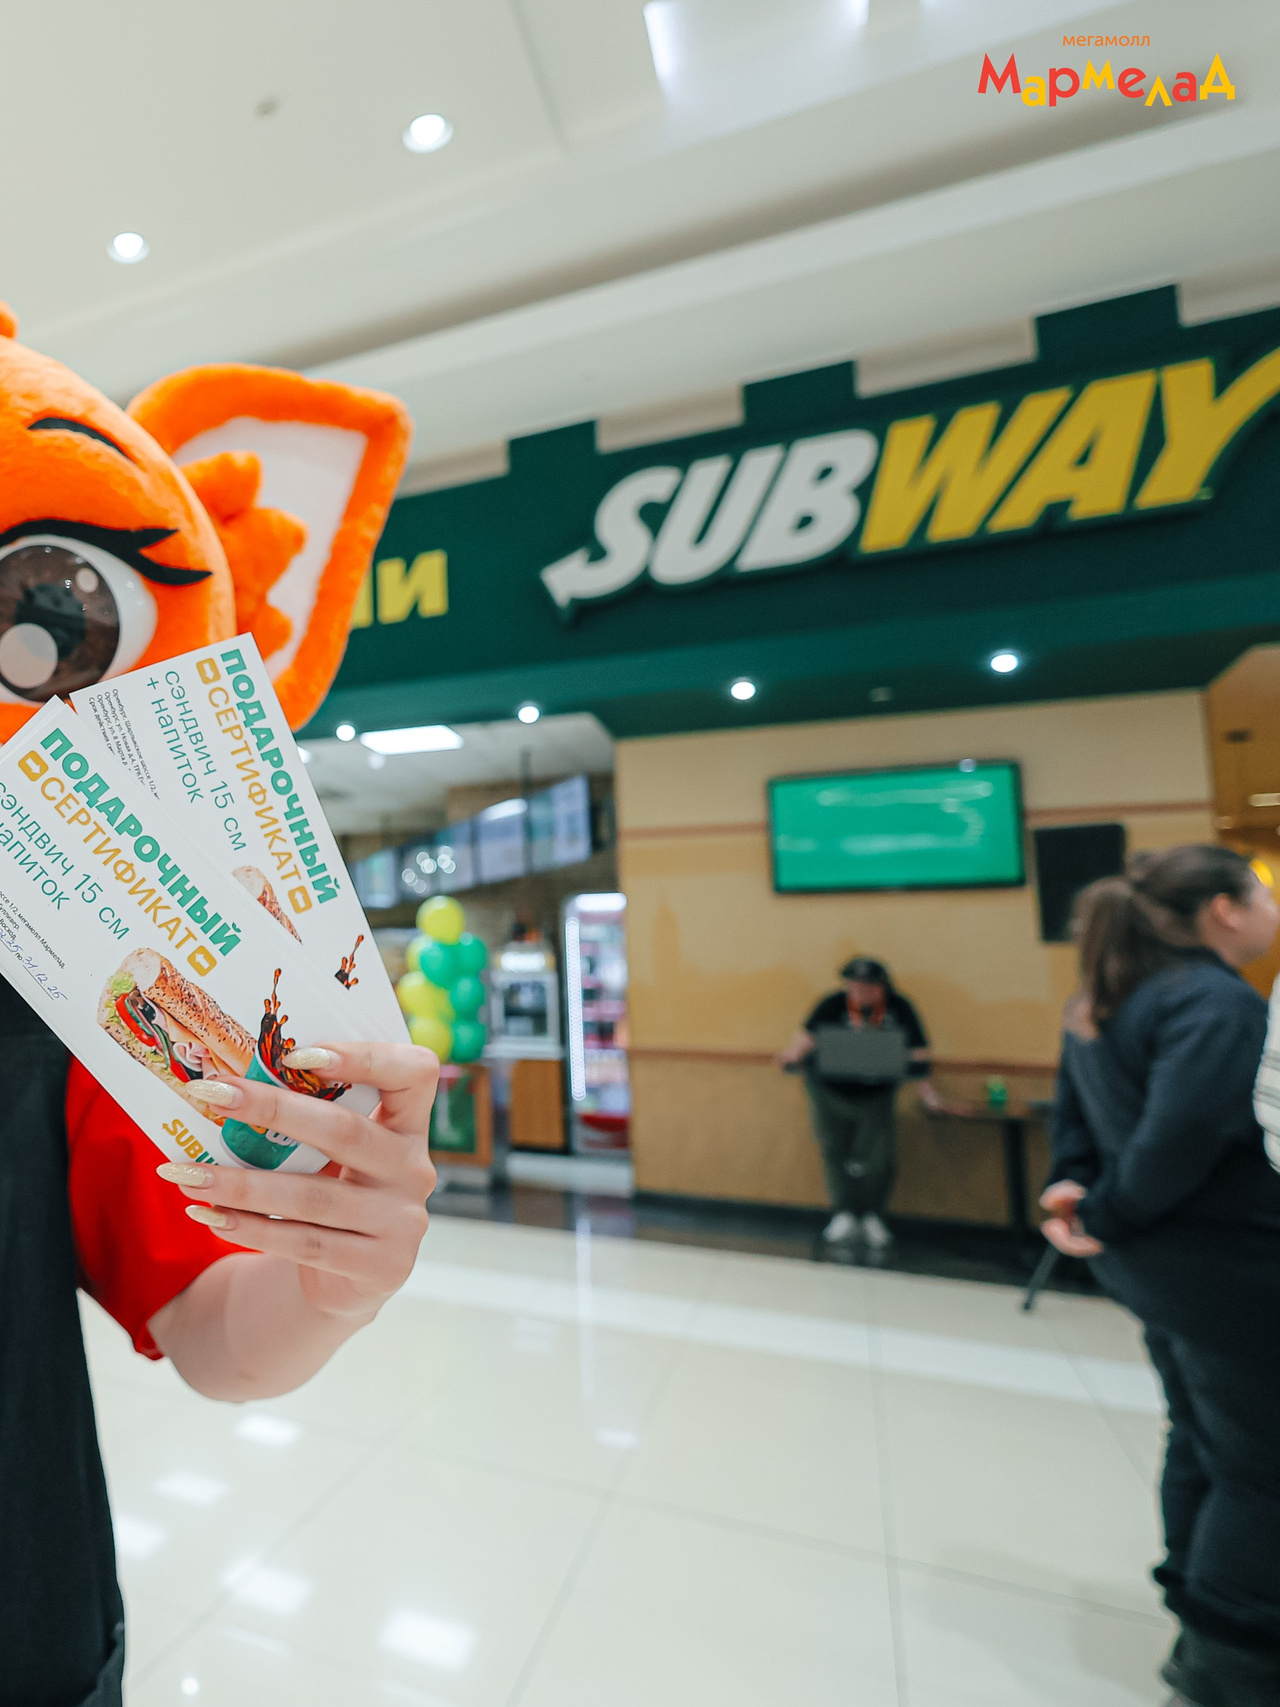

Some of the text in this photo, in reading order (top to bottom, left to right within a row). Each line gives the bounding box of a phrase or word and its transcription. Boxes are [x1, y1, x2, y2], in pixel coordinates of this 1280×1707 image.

[542, 345, 1280, 608] SUBWAY
[89, 697, 109, 742] Срок действия
[115, 741, 125, 763] Марта
[121, 733, 131, 752] Новая
[147, 677, 204, 803] + напиток
[165, 671, 248, 853] сэндвич 15 см
[220, 649, 340, 904] ПОДАРОЧНЫЙ
[40, 727, 241, 957] ПОДАРОЧНЫЙ
[208, 687, 301, 880] СЕРТИФИКАТ
[9, 903, 18, 915] 1/2,
[17, 913, 41, 940] мегамолл
[41, 777, 197, 949] СЕРТИФИКАТ
[74, 874, 103, 903] 15
[99, 907, 130, 940] см
[15, 952, 23, 960] по
